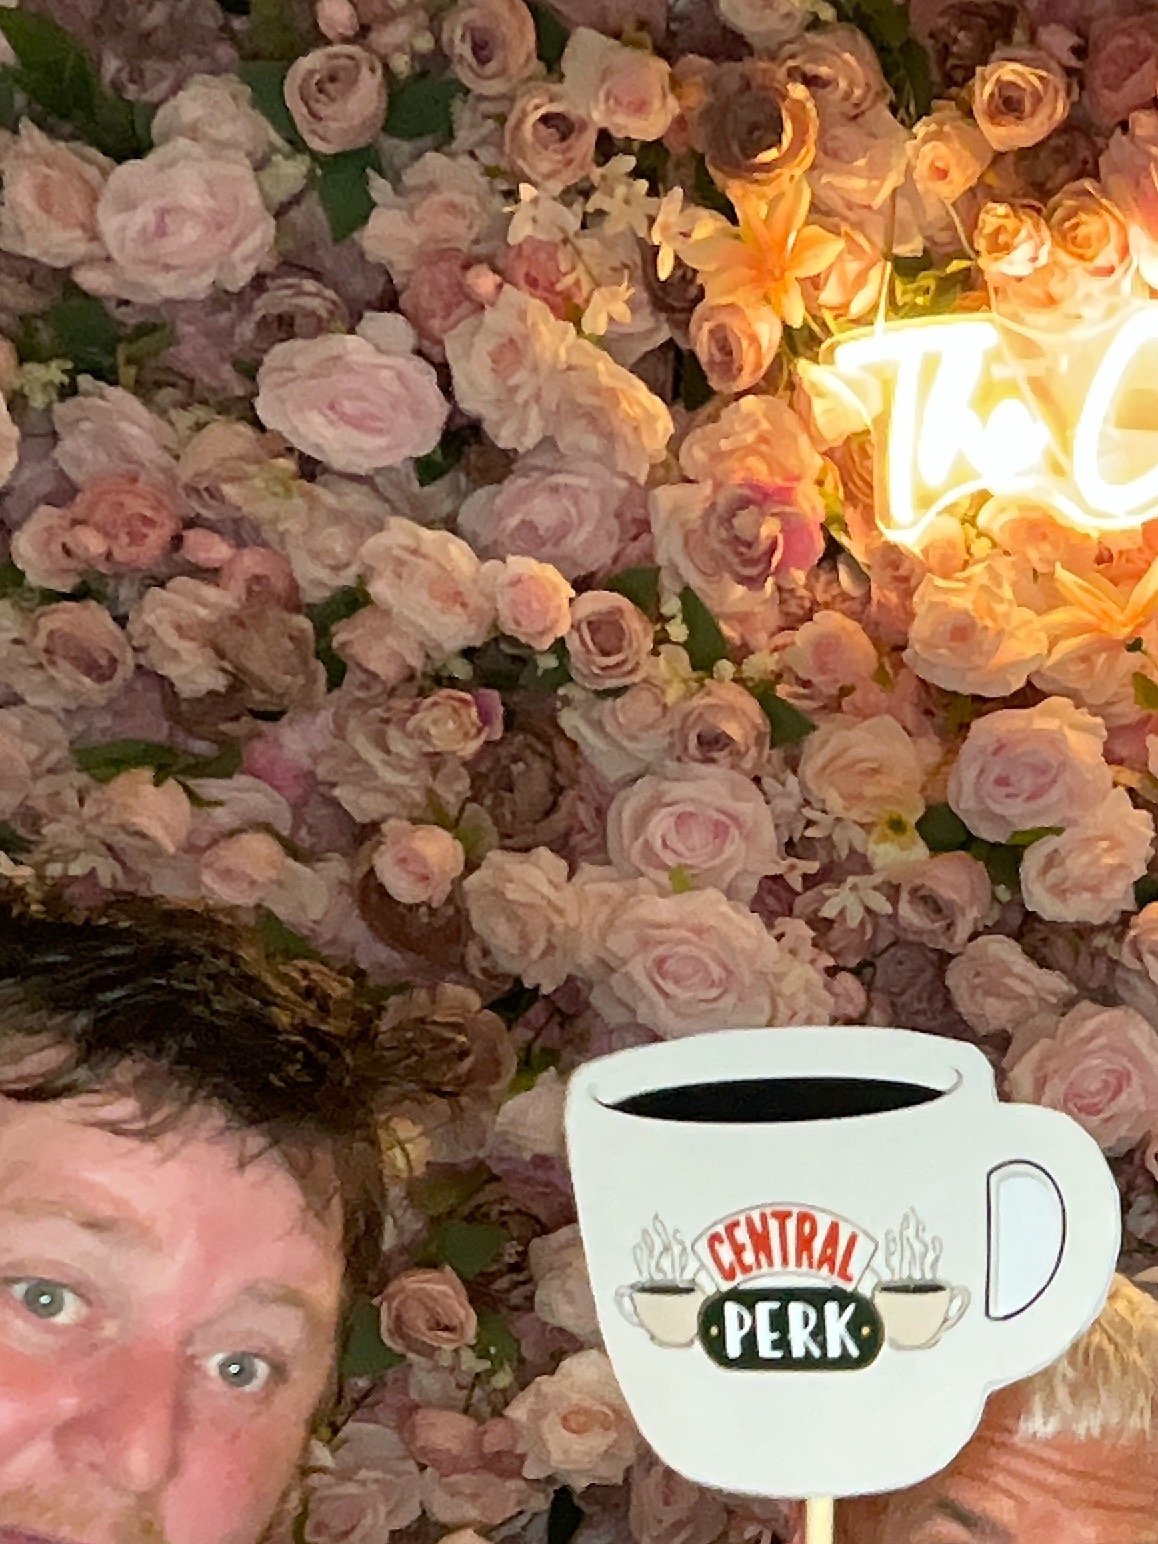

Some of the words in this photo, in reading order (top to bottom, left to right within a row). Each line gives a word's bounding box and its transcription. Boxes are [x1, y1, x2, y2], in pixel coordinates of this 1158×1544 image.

[835, 320, 1053, 525] The
[706, 1209, 860, 1283] CENTRAL
[722, 1299, 861, 1360] PERK
